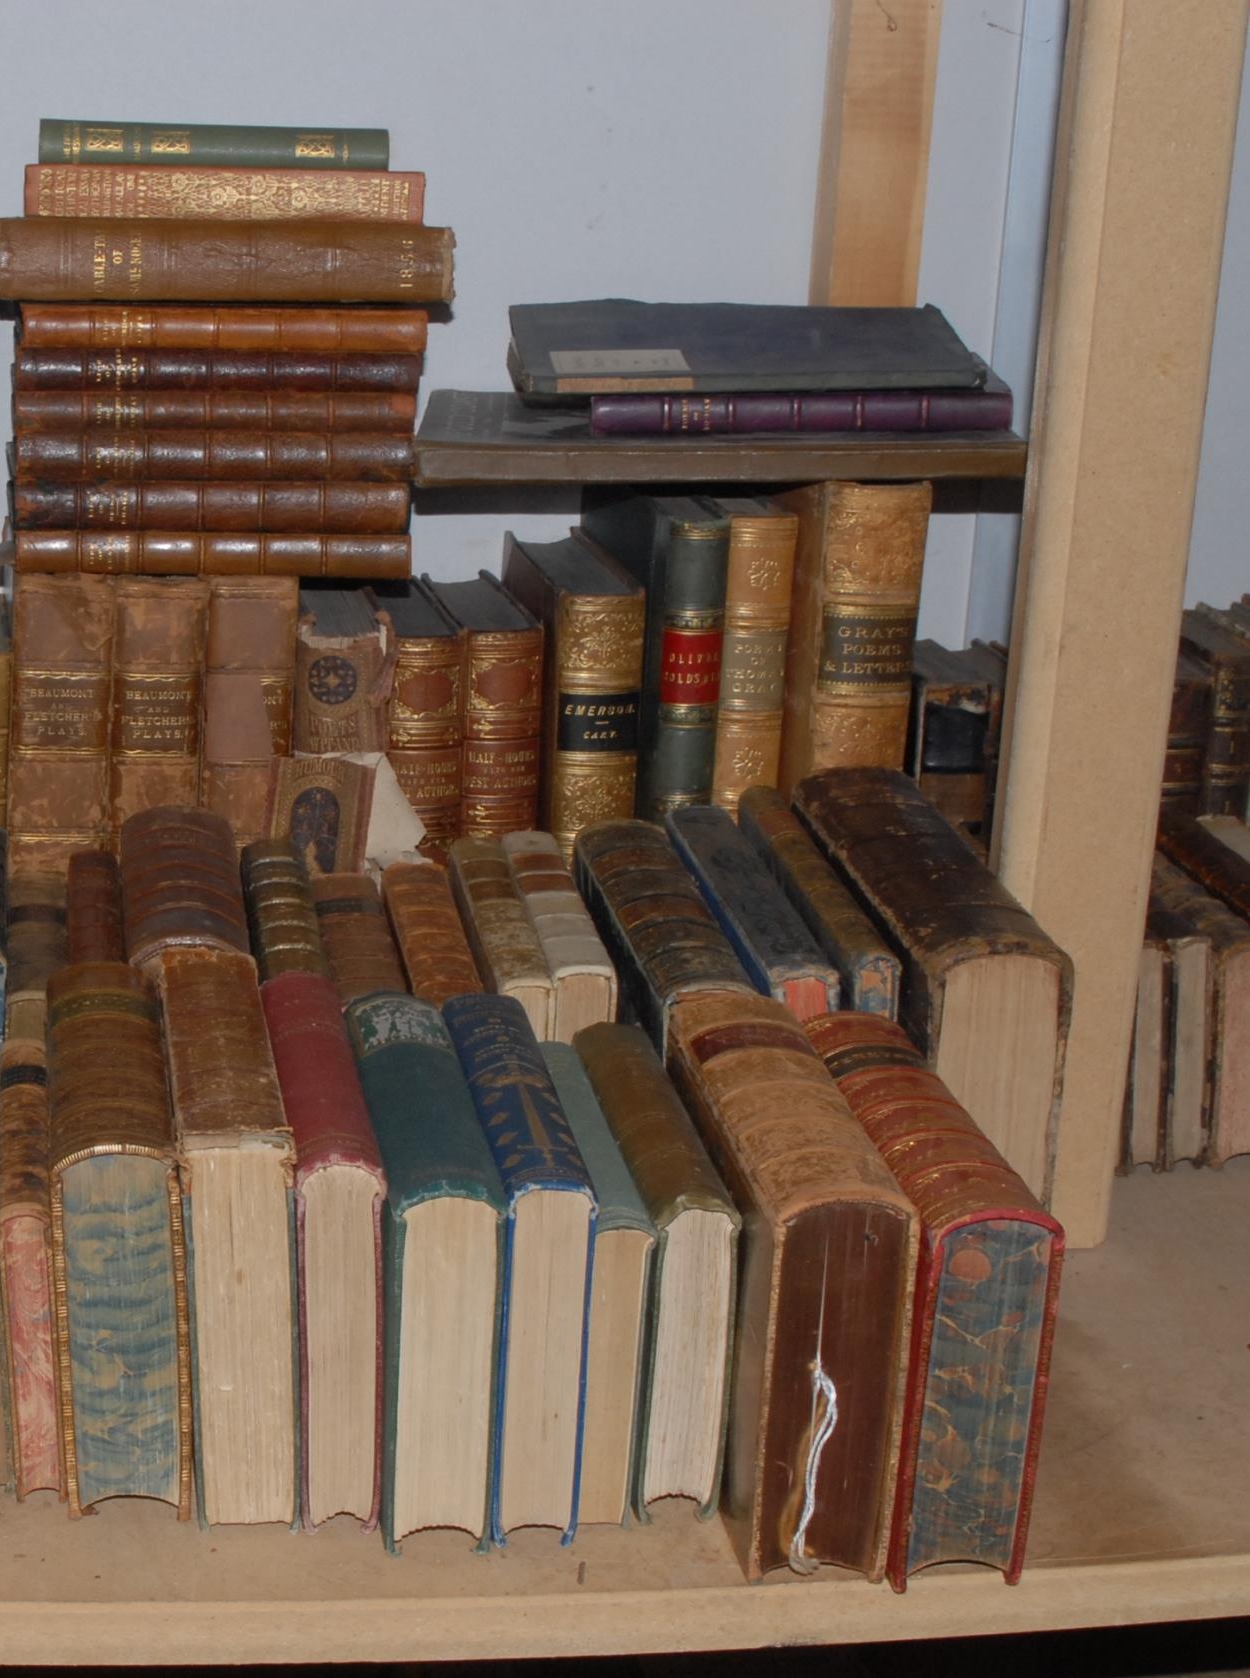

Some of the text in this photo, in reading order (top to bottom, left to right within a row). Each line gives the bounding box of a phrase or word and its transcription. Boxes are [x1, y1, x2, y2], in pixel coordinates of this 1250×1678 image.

[112, 249, 123, 264] OF
[398, 239, 415, 288] 1856
[838, 626, 908, 638] GRAY'S
[841, 643, 902, 656] POEMS
[823, 660, 837, 672] &
[30, 688, 94, 699] BEAUMONT
[125, 690, 191, 702] BEAUMONT
[564, 703, 636, 717] EMERSON.
